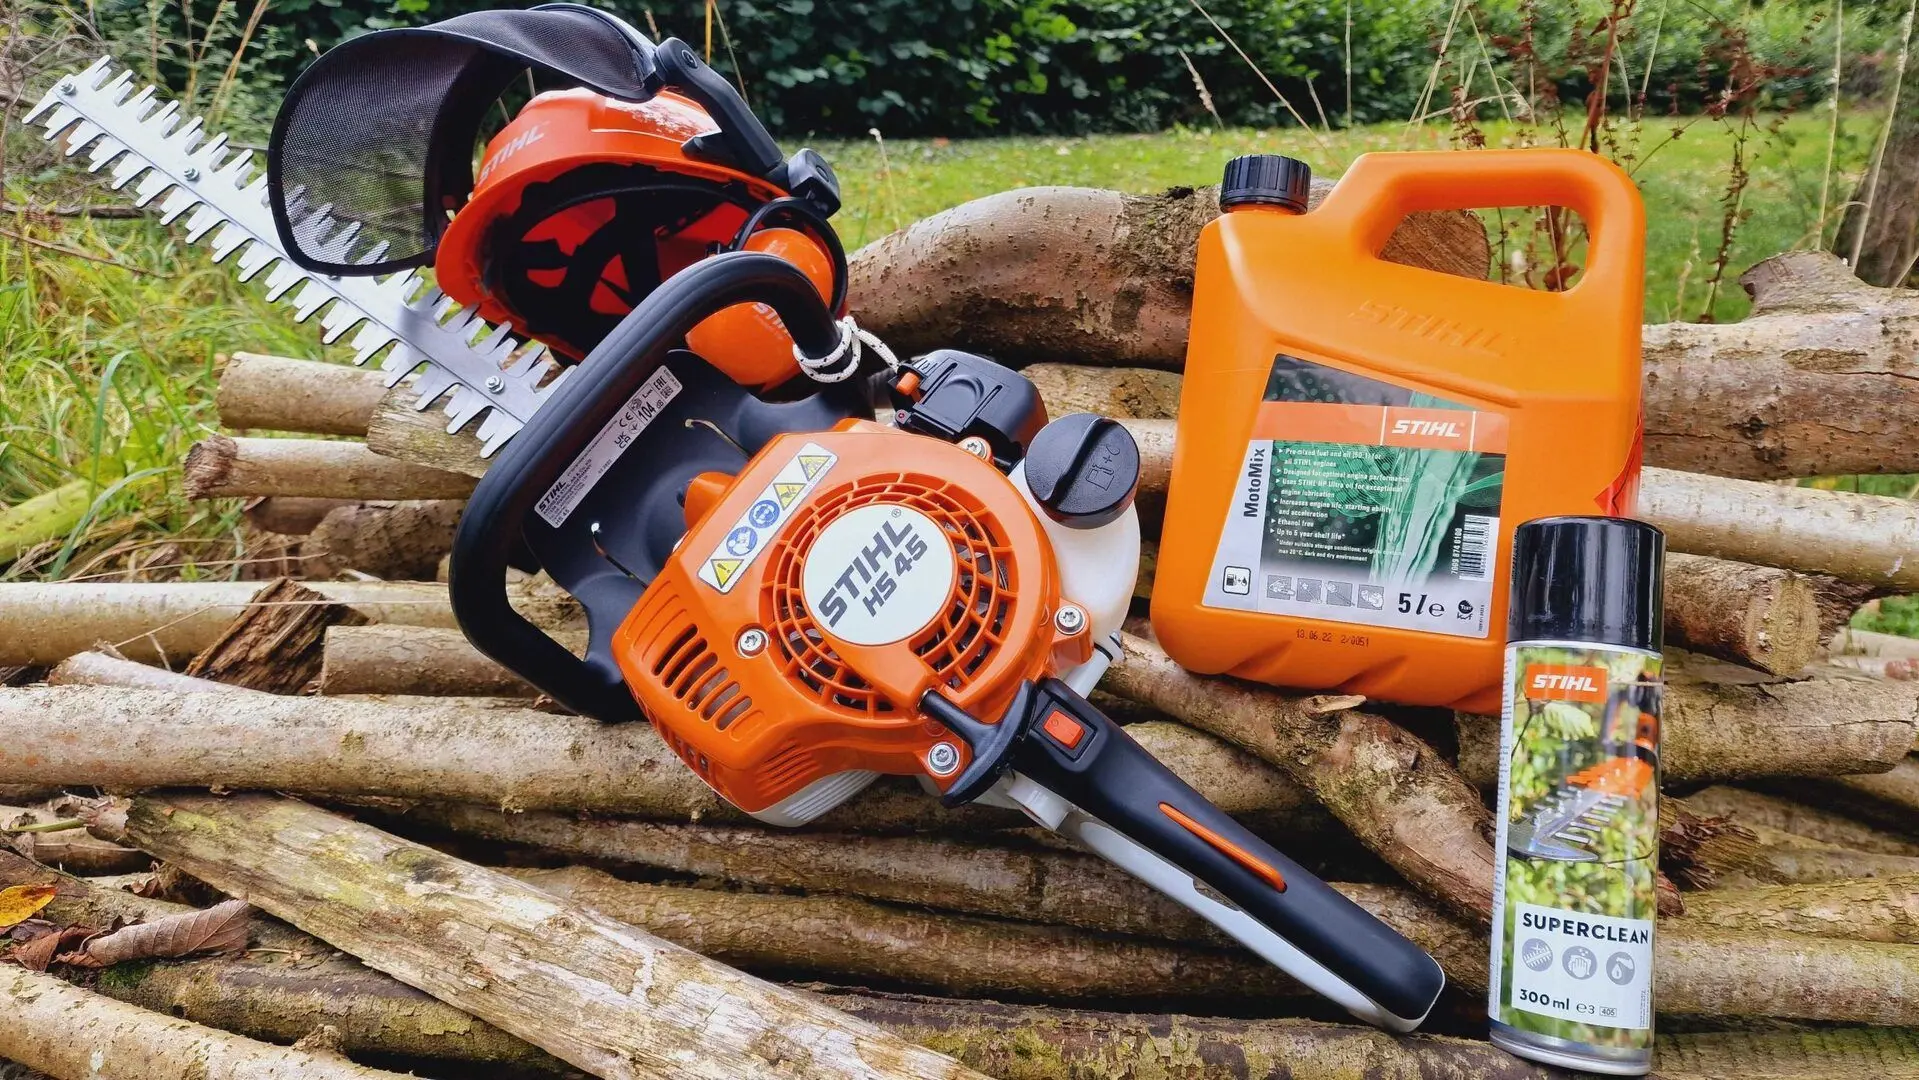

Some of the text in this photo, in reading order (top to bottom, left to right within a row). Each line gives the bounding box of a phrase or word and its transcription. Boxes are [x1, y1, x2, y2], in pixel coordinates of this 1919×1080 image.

[478, 125, 545, 187] STIHL
[1348, 299, 1507, 358] STIHL
[619, 411, 633, 427] CE
[638, 402, 656, 421] 104
[1391, 419, 1460, 438] STIHL
[1285, 448, 1315, 456] Pre-mixed
[1313, 460, 1336, 468] engines
[1243, 448, 1266, 518] MotoMix
[1283, 468, 1311, 476] Designed
[1322, 471, 1346, 479] optimal
[1347, 473, 1368, 481] engine
[1369, 474, 1410, 483] performance
[1281, 489, 1335, 498] engine lubrication
[1346, 482, 1354, 490] oil
[1365, 484, 1403, 493] exceptional
[539, 482, 566, 512] STIHL
[1280, 499, 1308, 507] Increases
[1309, 501, 1330, 509] engine
[1345, 503, 1370, 512] starting
[1371, 505, 1392, 513] ability
[1291, 509, 1328, 518] acceleration
[1278, 518, 1300, 526] Ethanol
[1314, 531, 1329, 539] shelf
[1314, 542, 1333, 550] storage
[1327, 552, 1335, 560] dry
[1336, 553, 1368, 562] environment
[818, 520, 913, 628] STIHL
[862, 533, 928, 617] HS 45
[1398, 592, 1411, 614] 5
[1532, 674, 1598, 692] STIHL
[1523, 912, 1649, 944] SUPERCLEAN
[1520, 988, 1550, 1006] 300
[1553, 998, 1570, 1011] ml
